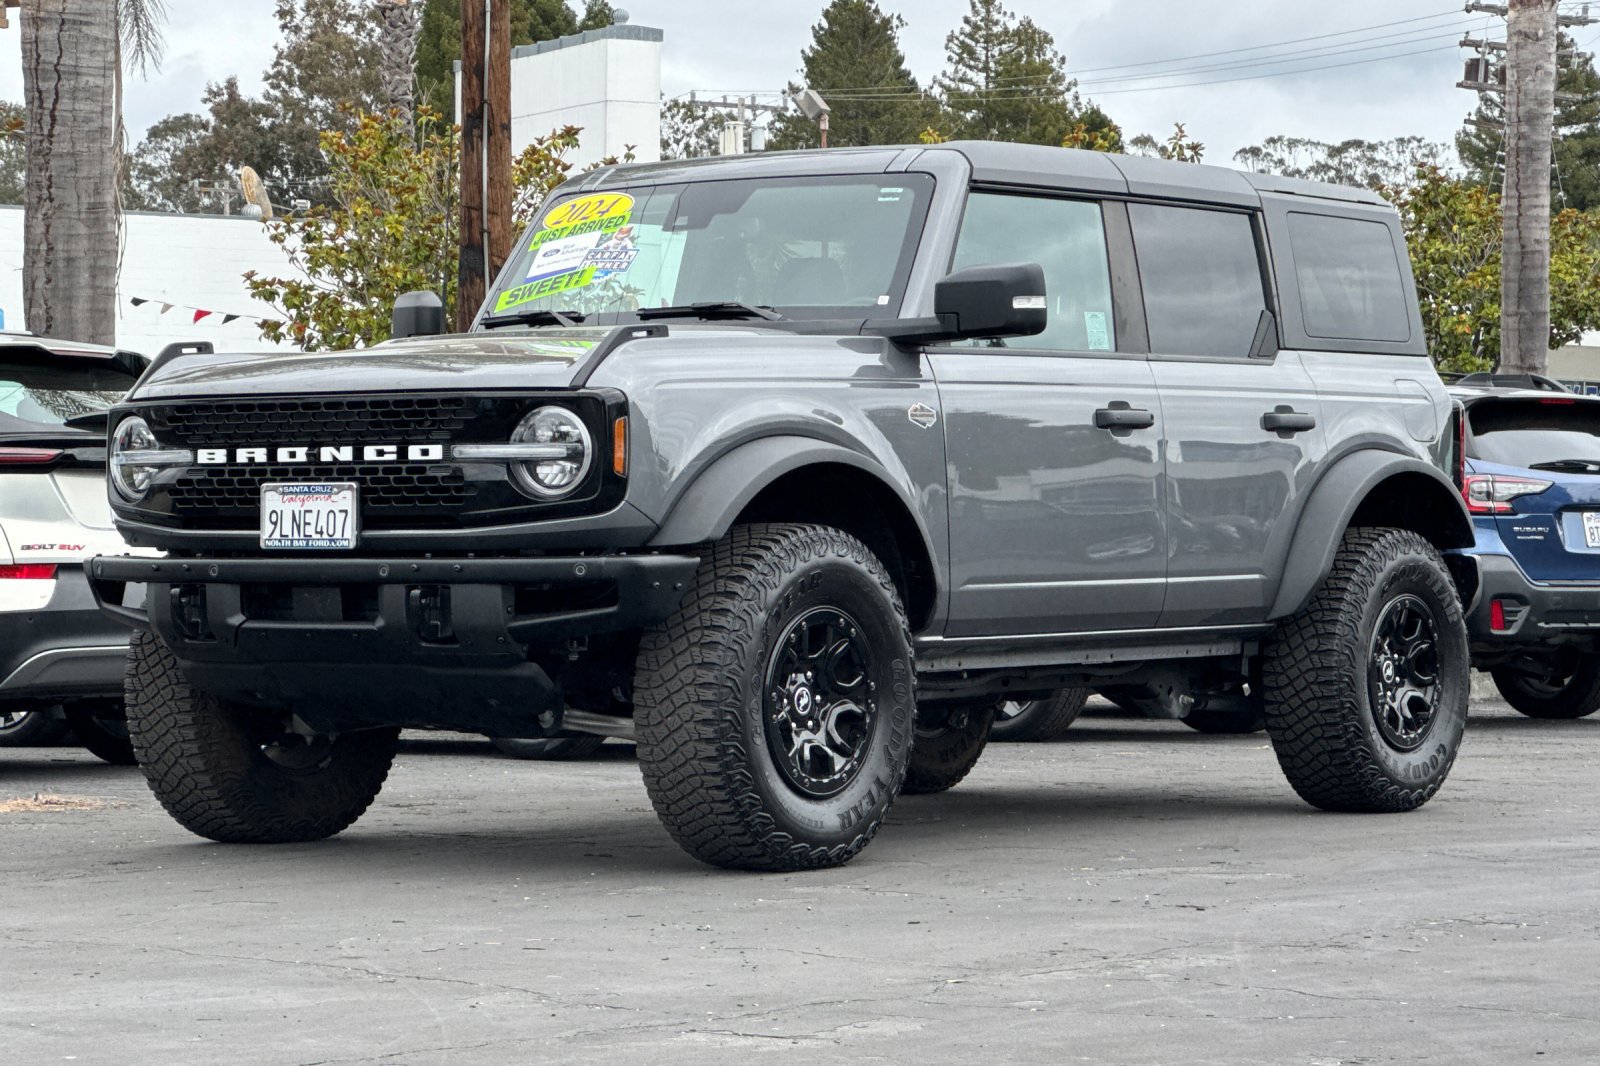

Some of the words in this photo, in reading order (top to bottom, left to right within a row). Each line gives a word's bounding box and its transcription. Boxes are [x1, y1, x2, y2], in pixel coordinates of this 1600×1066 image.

[551, 196, 624, 226] 2024
[533, 226, 566, 247] JUST
[568, 214, 626, 237] ARRIVED
[586, 251, 634, 260] CARFAX
[505, 268, 586, 305] SWEET!
[197, 444, 443, 464] BRONCO
[281, 494, 339, 508] California
[268, 509, 349, 538] 9LNE407
[20, 543, 57, 551] BOLT
